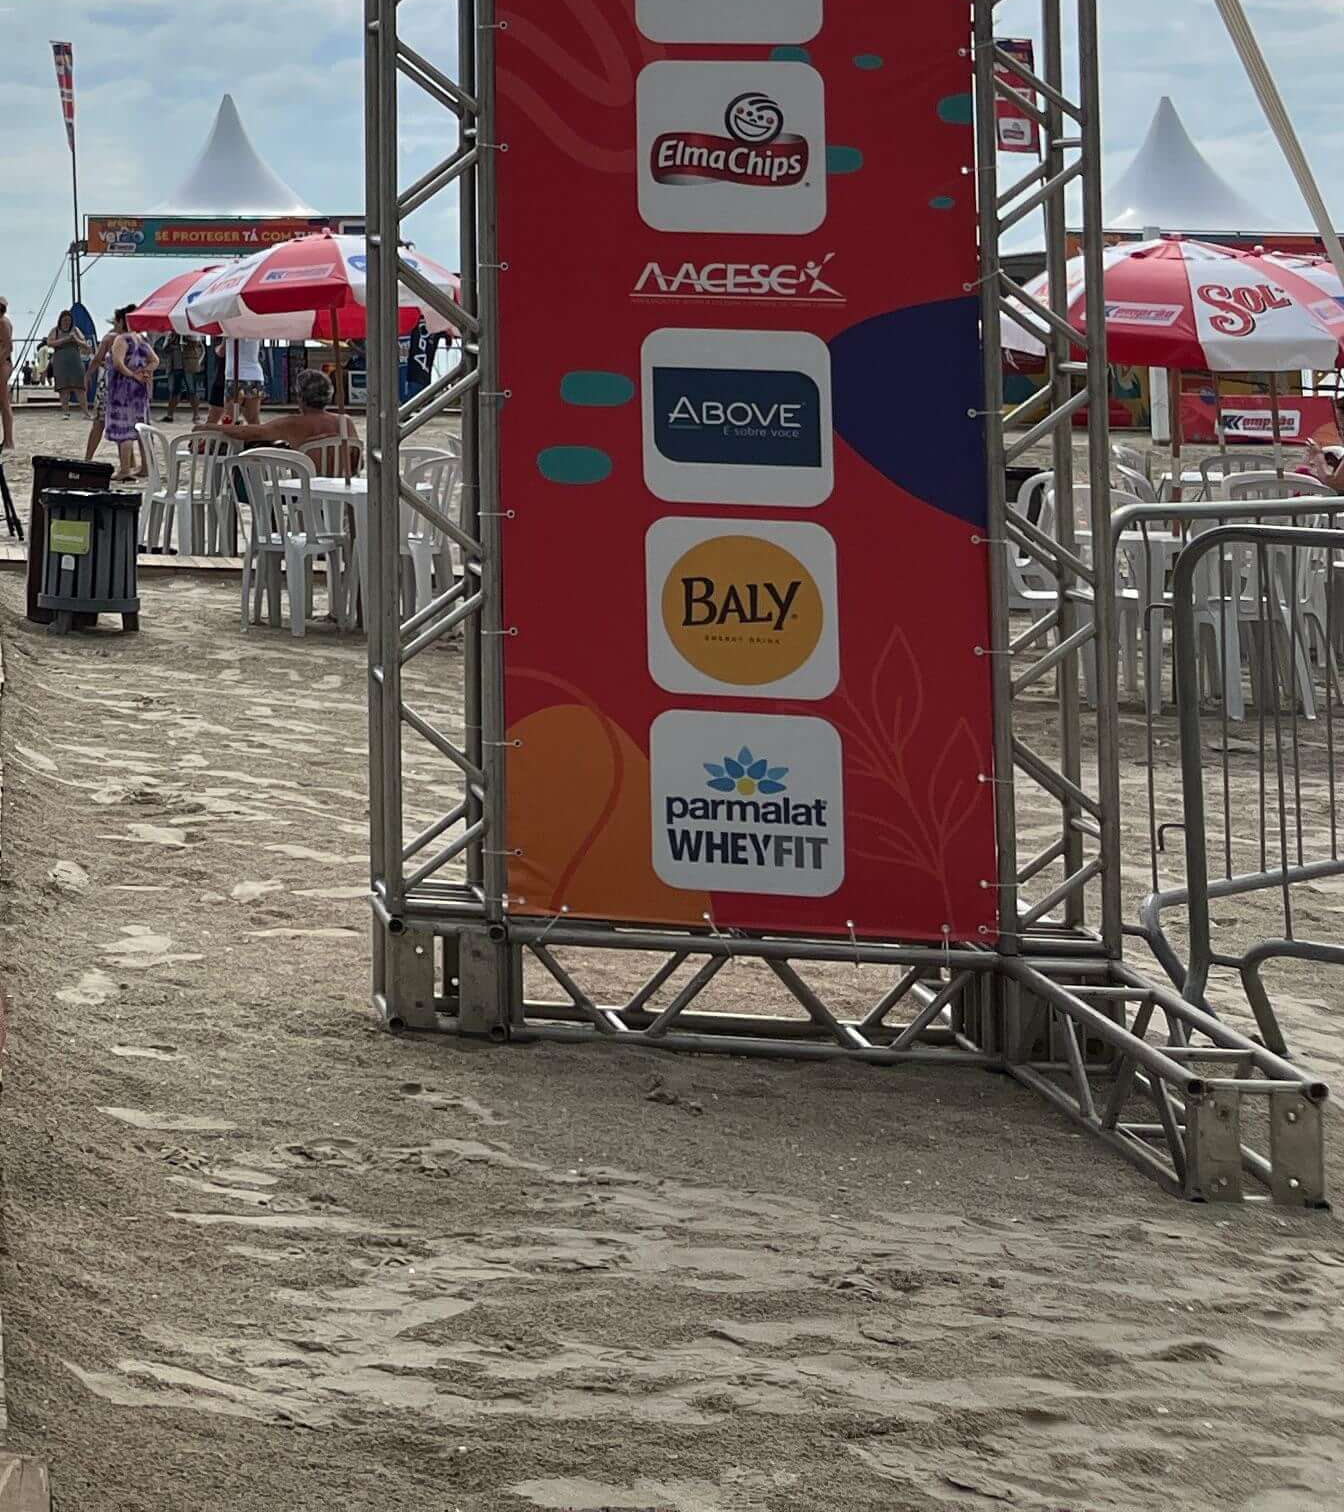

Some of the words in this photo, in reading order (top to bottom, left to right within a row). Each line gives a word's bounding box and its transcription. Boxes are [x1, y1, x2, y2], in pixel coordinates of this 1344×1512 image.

[155, 232, 168, 240] SE
[172, 231, 241, 241] PROTEGER
[242, 228, 259, 241] TÁ
[262, 231, 291, 241] COM
[668, 396, 802, 428] ABOVE
[734, 426, 767, 437] sobre
[681, 577, 802, 631] BALY
[666, 795, 827, 828] parmalat
[667, 828, 829, 870] WHEYFIT
